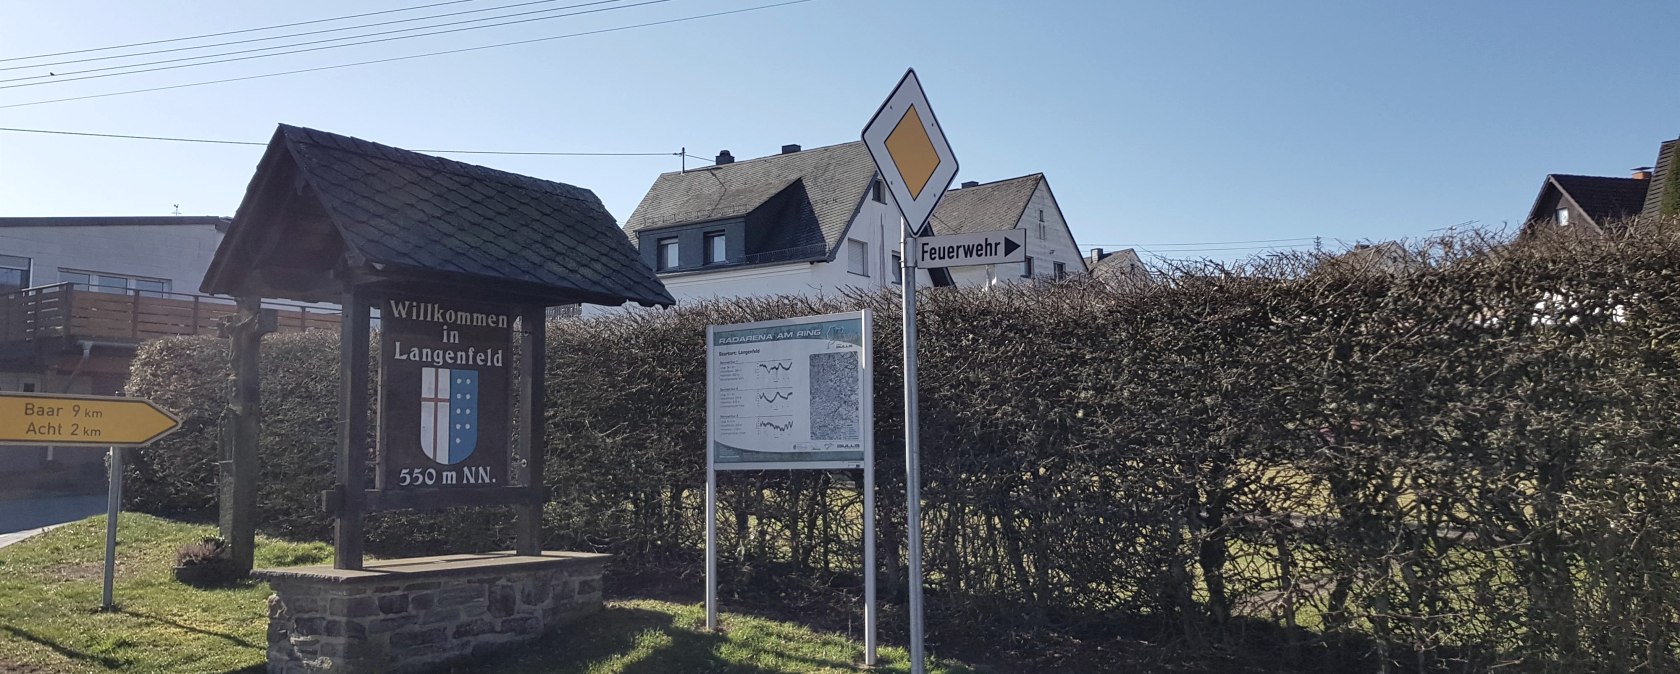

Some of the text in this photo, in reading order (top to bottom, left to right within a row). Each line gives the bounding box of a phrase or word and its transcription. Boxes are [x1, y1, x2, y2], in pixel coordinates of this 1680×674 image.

[921, 237, 1001, 262] Feuerwehr
[389, 299, 508, 328] Willkommen
[442, 325, 459, 344] in
[718, 329, 821, 345] RADARENA AM RING
[394, 341, 503, 367] Langenfeld
[24, 402, 103, 418] Baar 9 km
[25, 422, 101, 437] Acht 2 km
[399, 465, 496, 486] 550 m NN.
